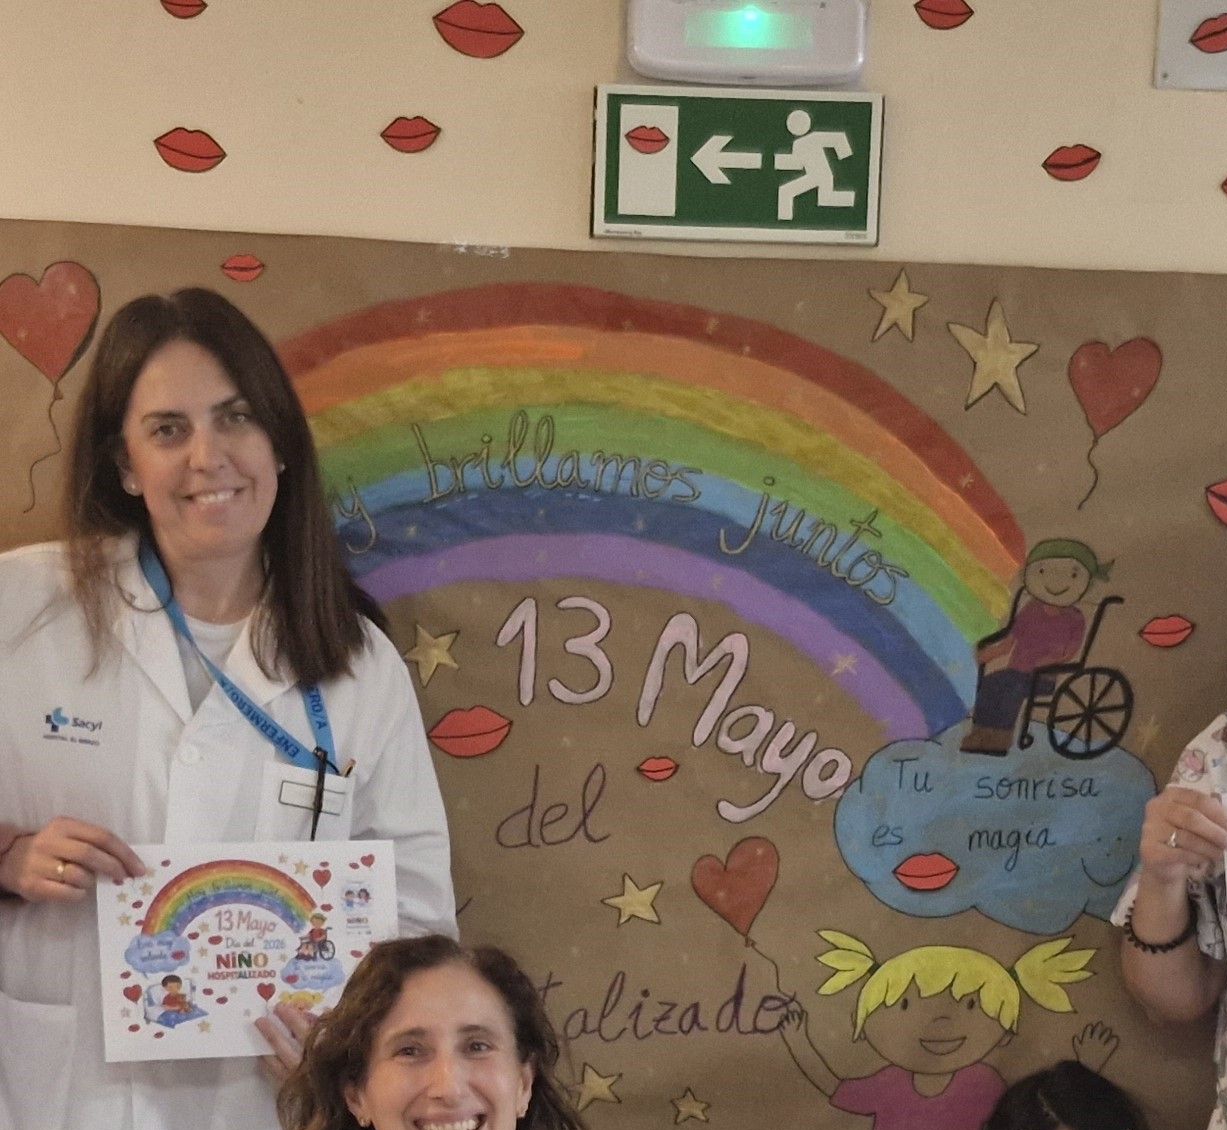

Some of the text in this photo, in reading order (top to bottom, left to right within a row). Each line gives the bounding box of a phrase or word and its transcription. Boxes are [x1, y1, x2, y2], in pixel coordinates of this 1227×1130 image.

[410, 409, 703, 502] brillamos
[719, 475, 910, 605] juntos
[496, 595, 853, 824] 13 Mayo
[495, 762, 612, 849] del
[892, 757, 1100, 801] Tu sonrisa
[871, 820, 1058, 873] es magia
[214, 909, 277, 940] 13 Mayo
